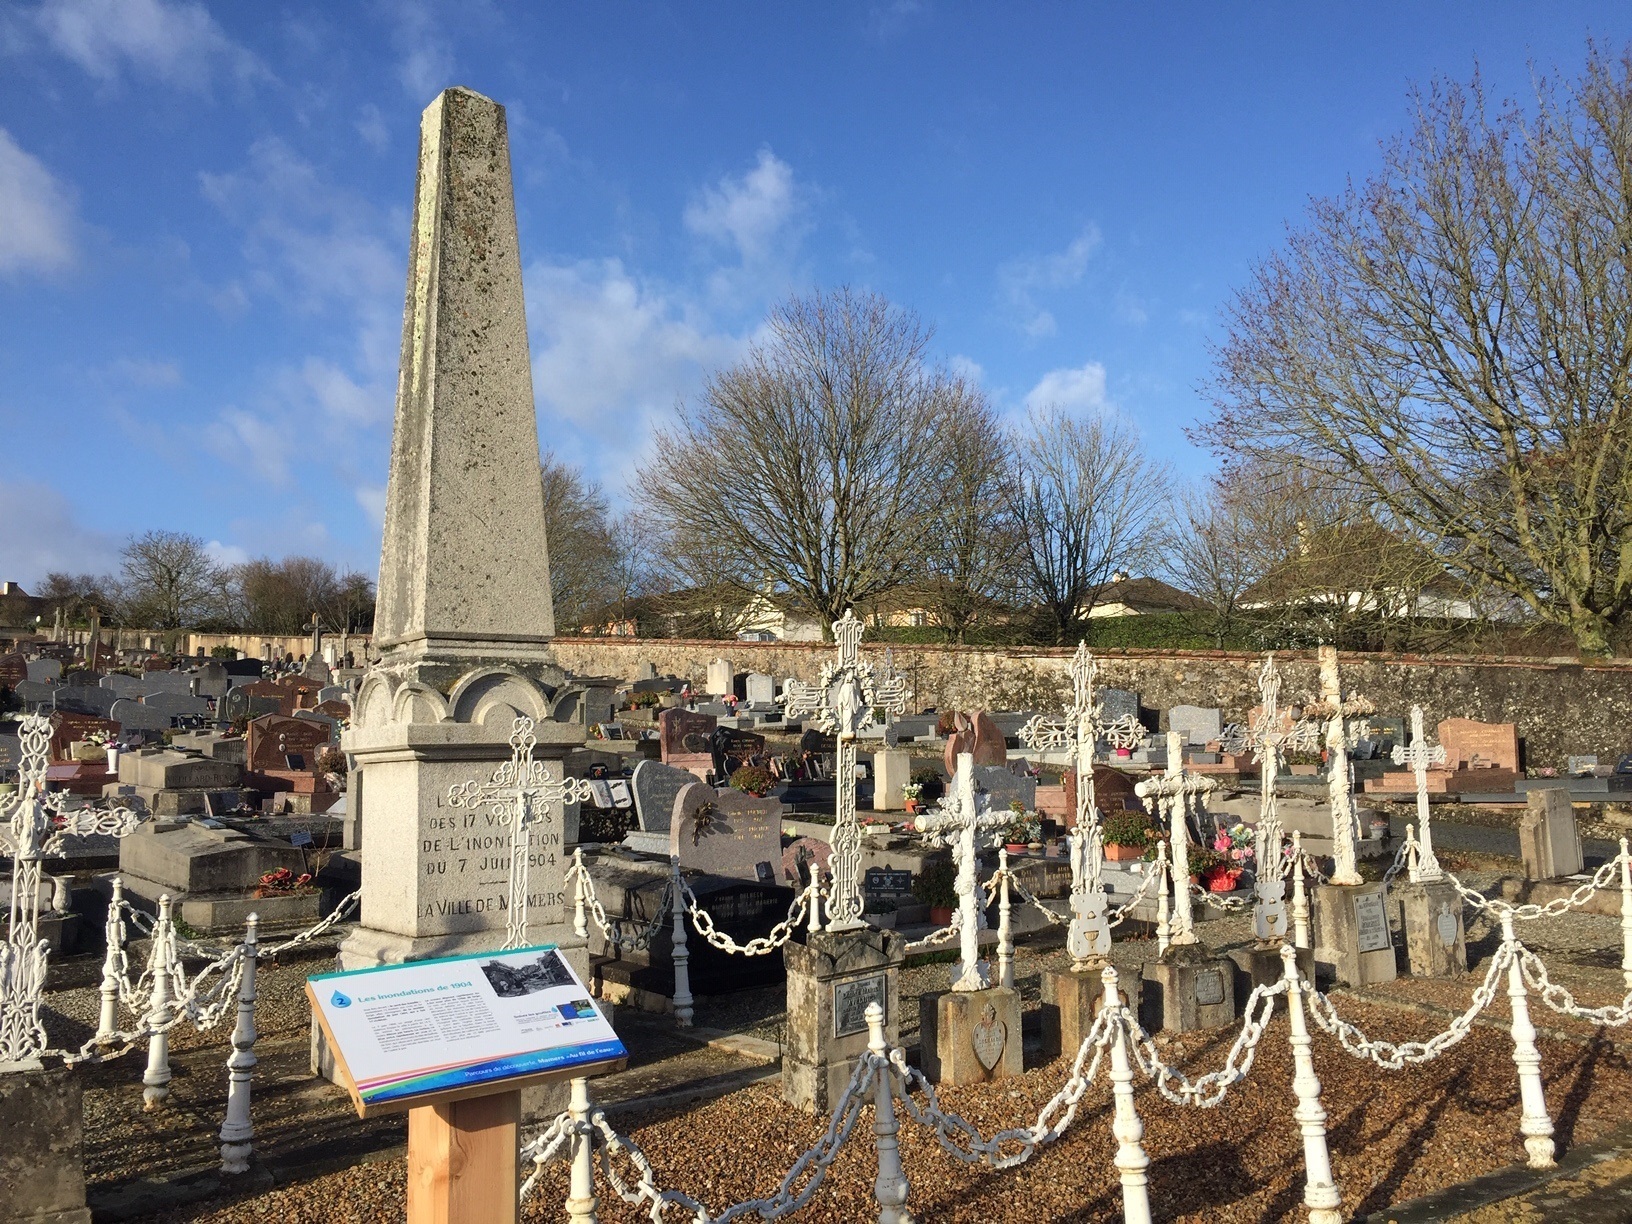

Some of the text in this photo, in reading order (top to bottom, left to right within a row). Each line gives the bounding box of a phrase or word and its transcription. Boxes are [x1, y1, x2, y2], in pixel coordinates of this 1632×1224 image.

[429, 817, 456, 829] DES
[464, 813, 476, 828] 17
[423, 833, 559, 853] DE L'INONDTION
[427, 860, 447, 875] DU
[458, 858, 468, 873] 7
[529, 853, 557, 868] 904
[417, 892, 565, 918] LA VILLE DE MMERS
[337, 998, 345, 1006] 2
[358, 980, 473, 1003] Les inondations de 1904
[464, 1068, 493, 1077] Parcours
[493, 1065, 502, 1073] de
[537, 1054, 565, 1065] Mamers
[586, 1049, 596, 1057] de
